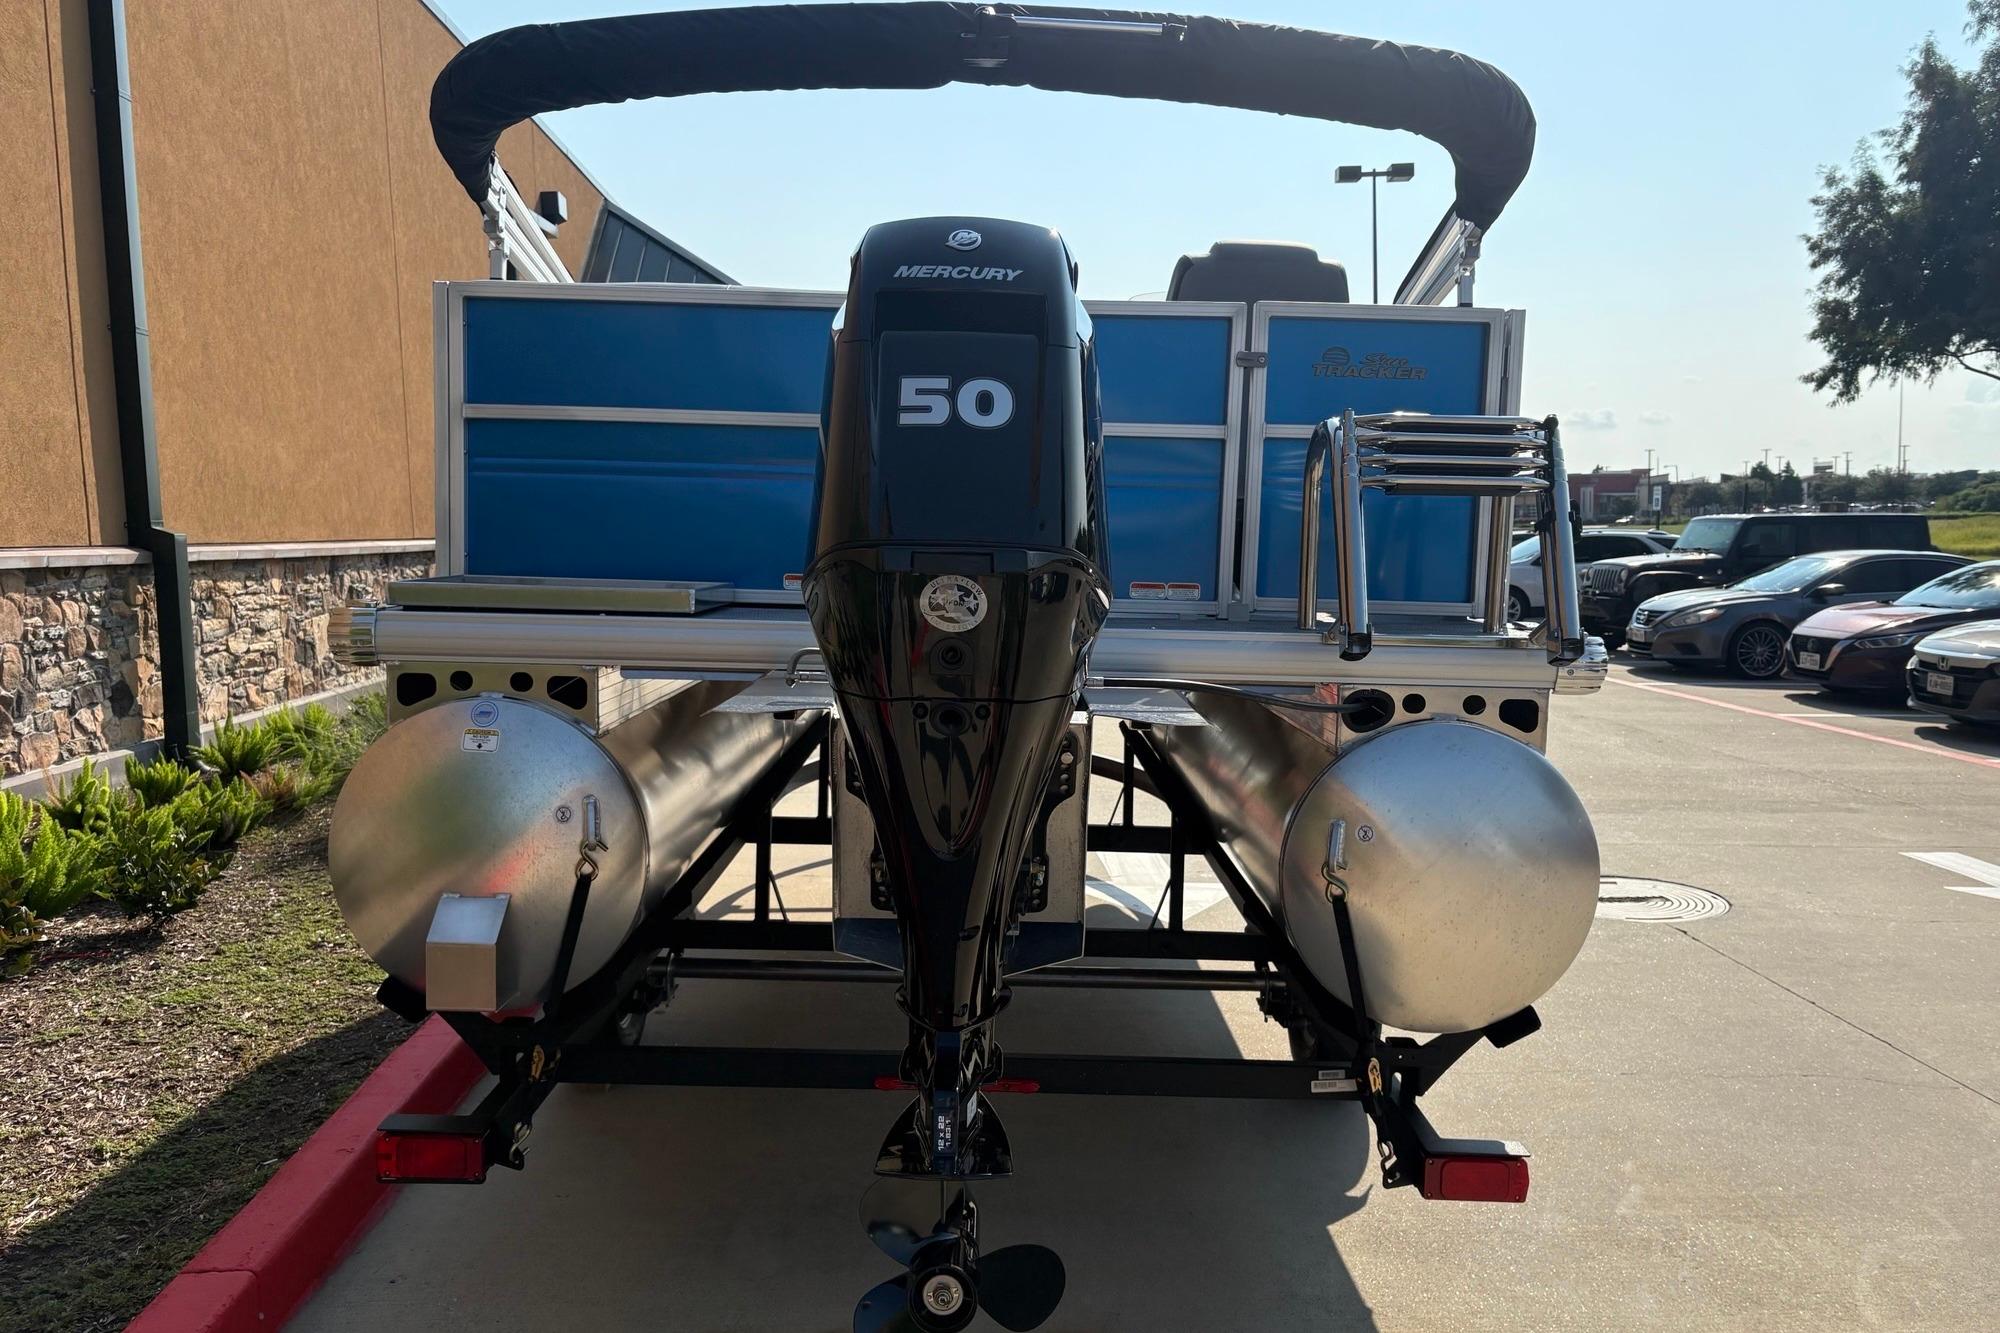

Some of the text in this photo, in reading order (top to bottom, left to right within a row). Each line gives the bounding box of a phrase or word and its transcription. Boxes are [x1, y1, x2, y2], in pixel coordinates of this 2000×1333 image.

[893, 265, 1023, 281] MERCURY
[1312, 363, 1428, 380] TRACKER
[898, 376, 1015, 429] 50
[938, 1116, 945, 1129] 22
[938, 1139, 945, 1151] 12
